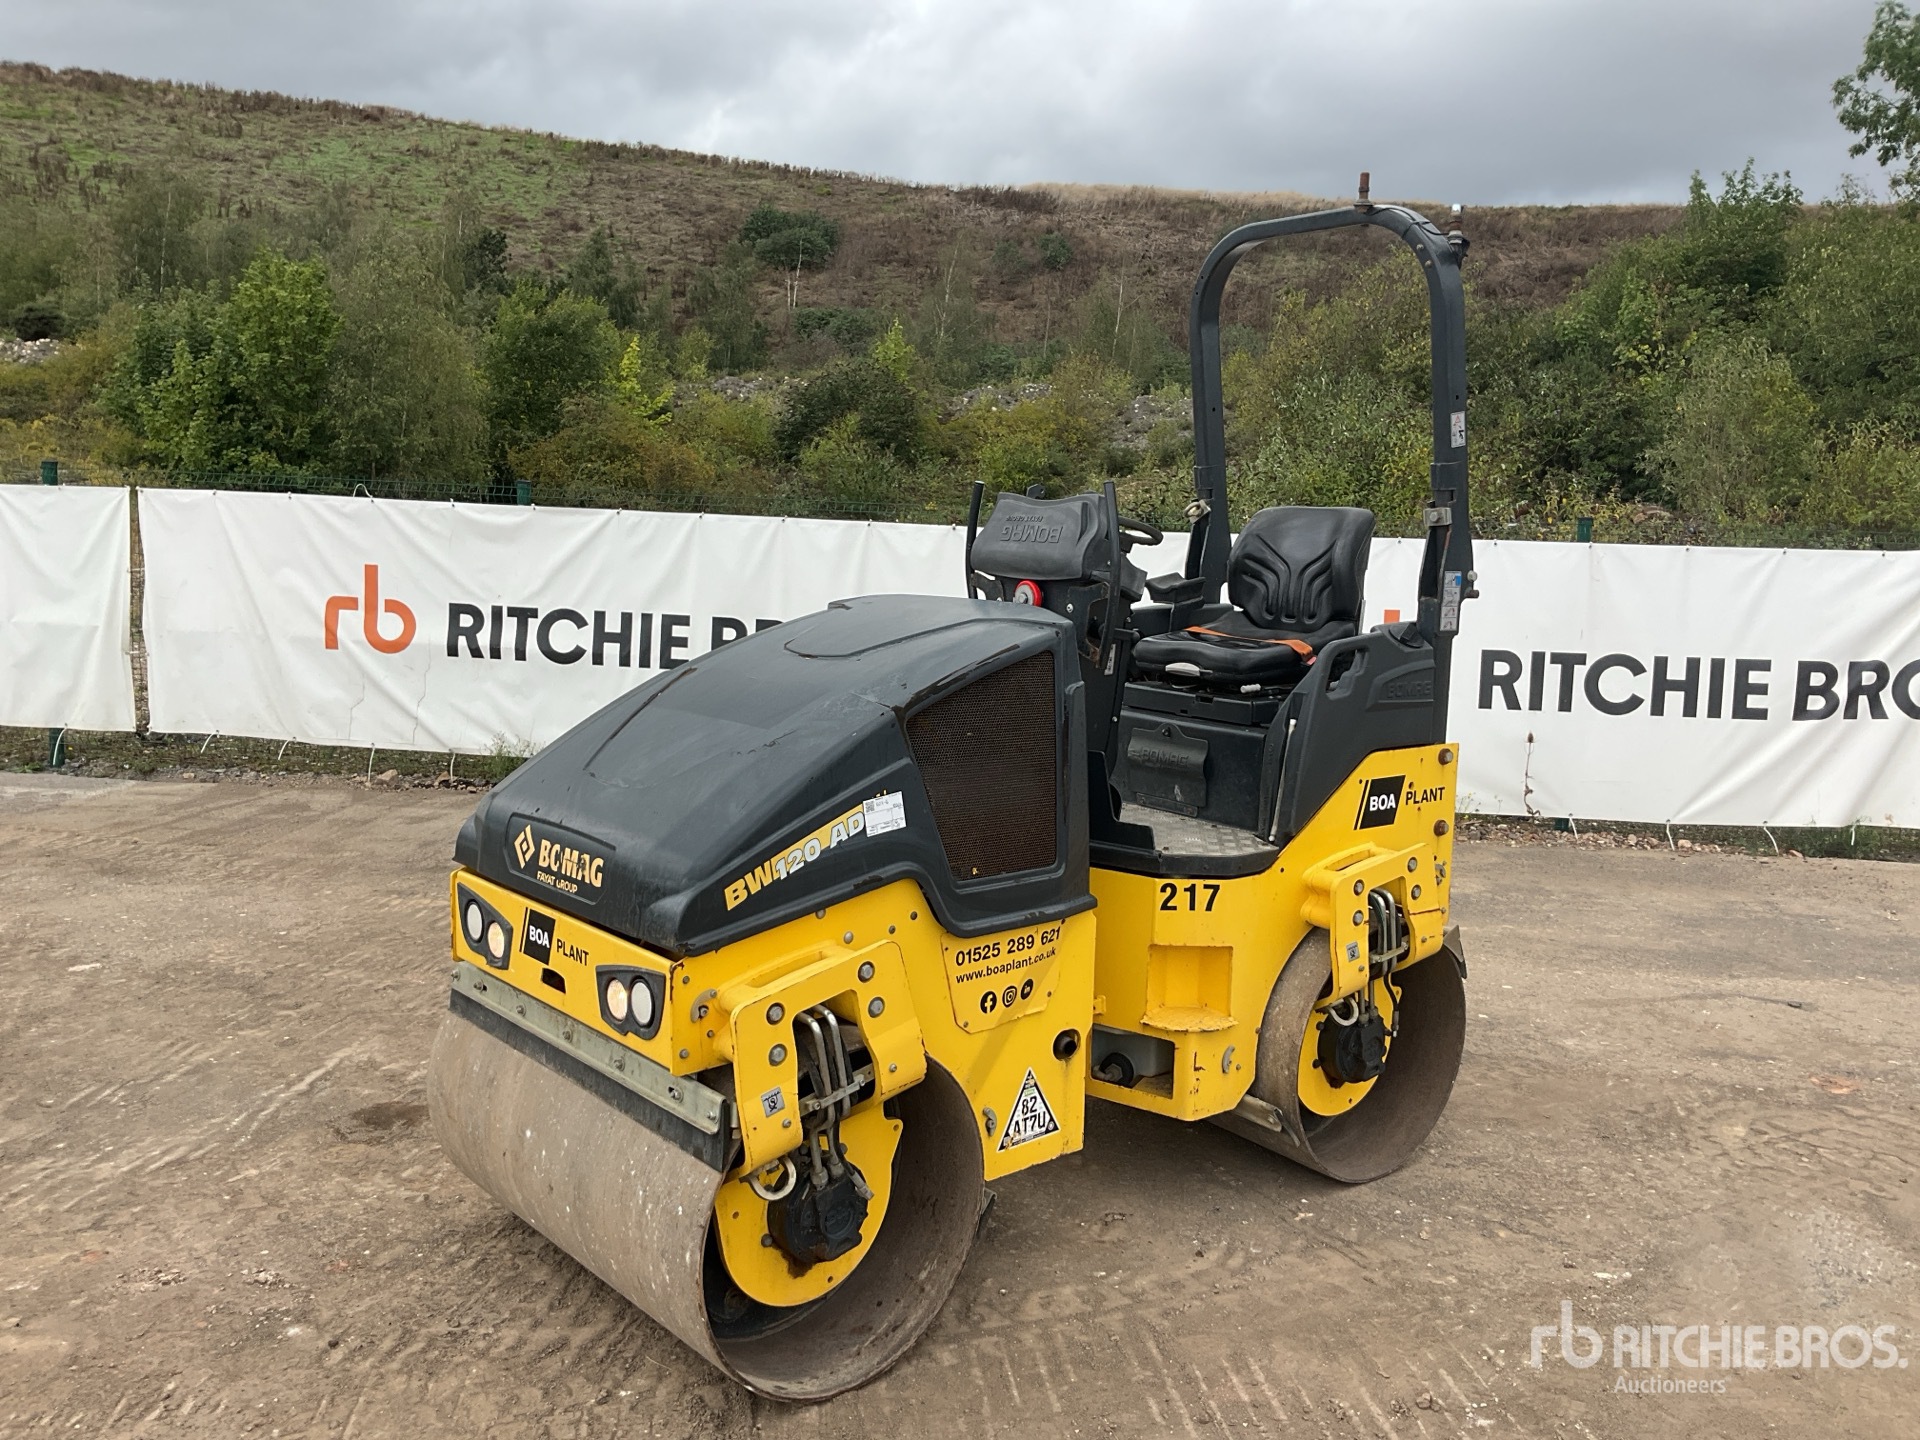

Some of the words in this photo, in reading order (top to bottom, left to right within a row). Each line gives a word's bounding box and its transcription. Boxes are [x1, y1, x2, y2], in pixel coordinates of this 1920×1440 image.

[447, 602, 691, 669] RITCHIE
[1478, 649, 1772, 720] RITCHIE
[1369, 793, 1396, 812] BOA
[1405, 786, 1445, 806] PLANT
[536, 871, 555, 886] FAYAT
[556, 880, 578, 894] GROUP
[1160, 882, 1221, 912] 217
[529, 925, 550, 949] BOA
[556, 938, 590, 966] PLANT
[955, 942, 1001, 967] 01525
[1007, 934, 1035, 954] 289
[1041, 926, 1061, 945] 621
[956, 947, 1056, 984] www.boaplant.co.uk
[1022, 1096, 1037, 1116] 82
[1013, 1111, 1046, 1137] AT7U
